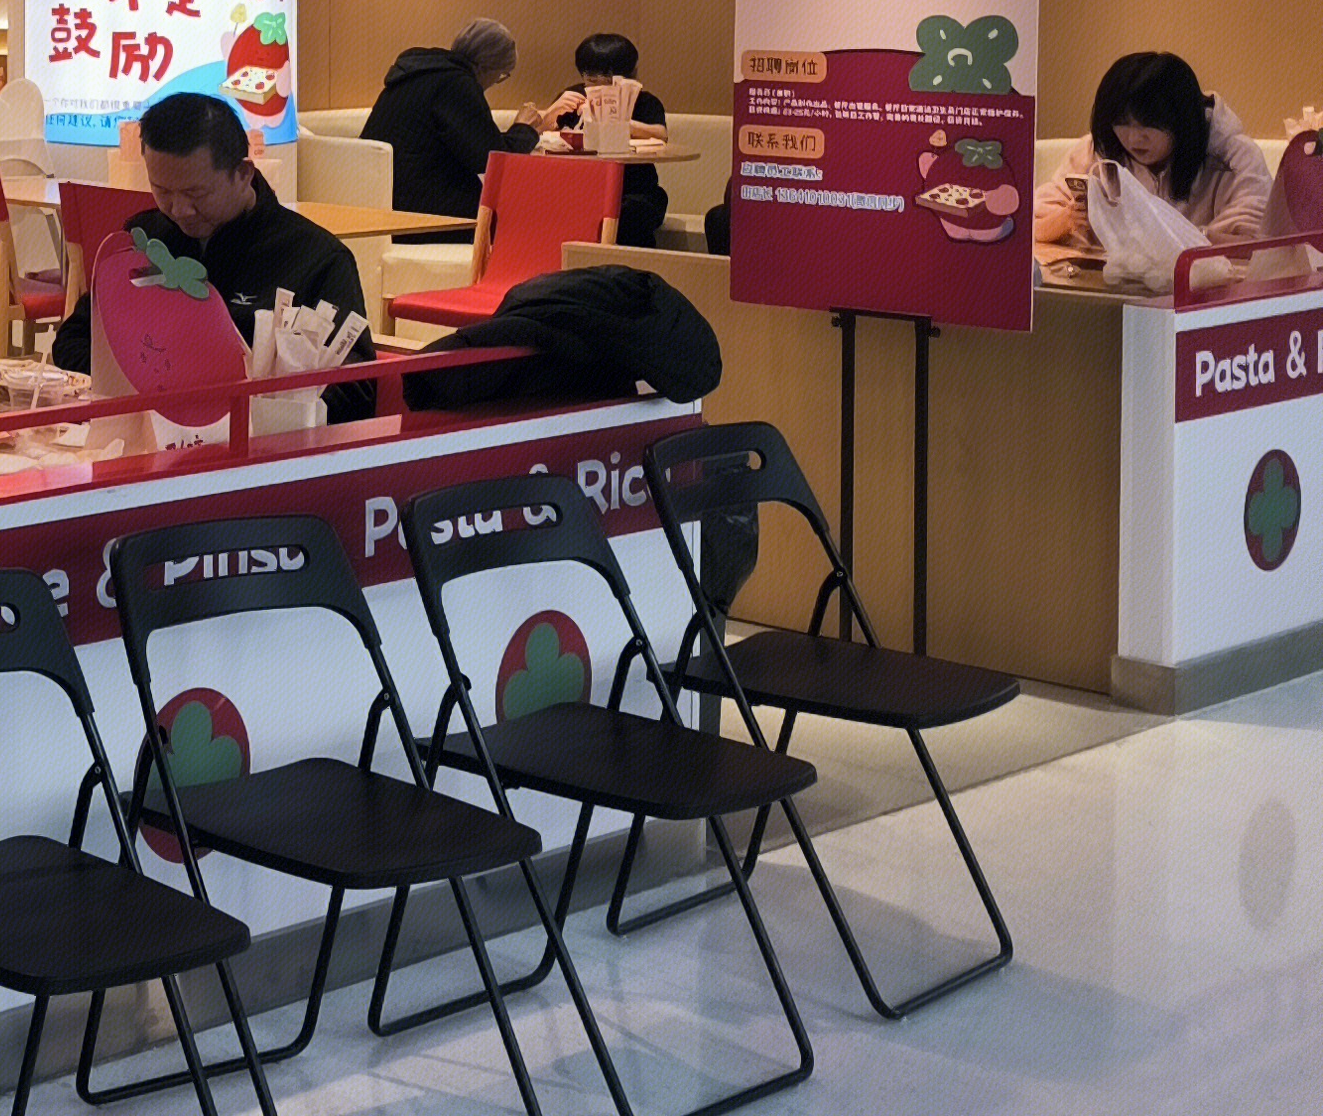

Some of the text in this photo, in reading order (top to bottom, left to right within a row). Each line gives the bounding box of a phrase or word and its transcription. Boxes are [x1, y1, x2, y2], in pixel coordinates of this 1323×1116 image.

[48, 2, 175, 83] 鼓励
[747, 131, 817, 152] 联系我们
[1195, 330, 1307, 398] Pasta &
